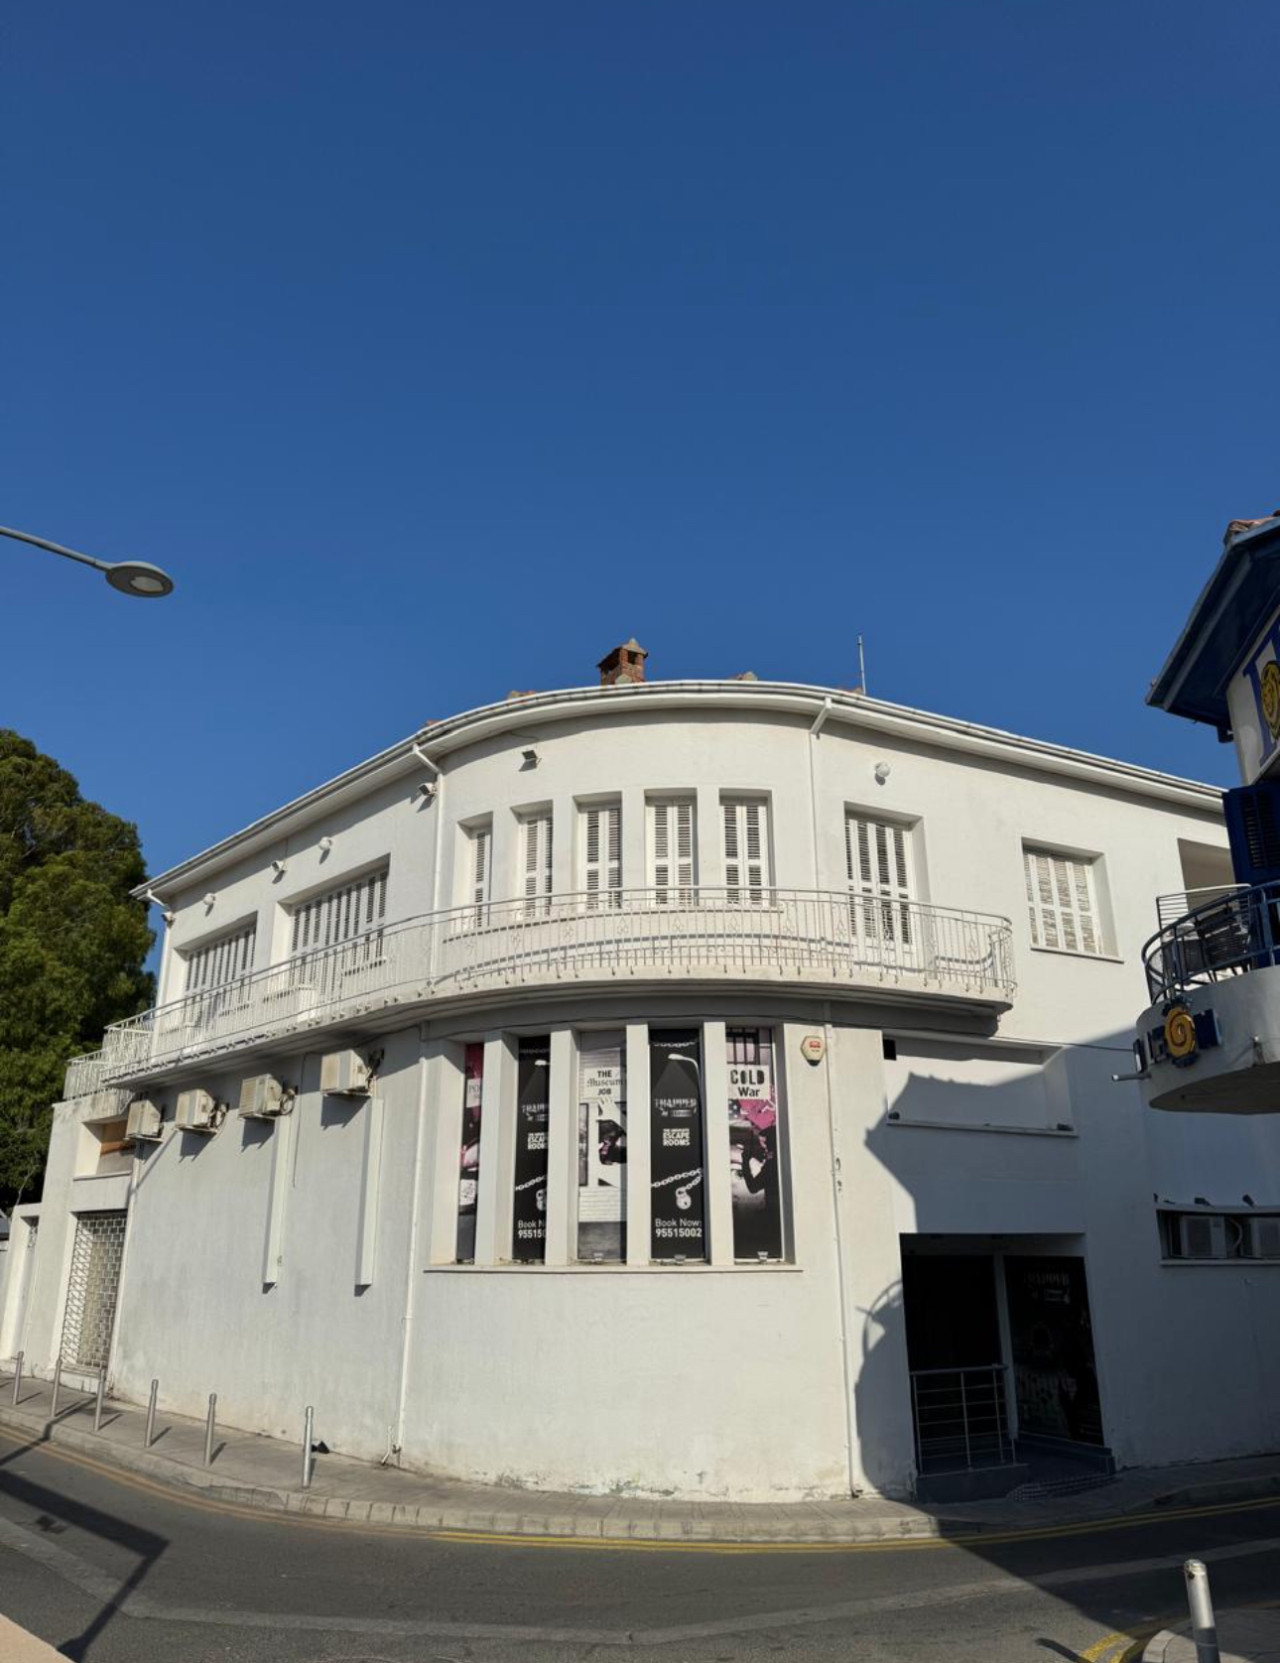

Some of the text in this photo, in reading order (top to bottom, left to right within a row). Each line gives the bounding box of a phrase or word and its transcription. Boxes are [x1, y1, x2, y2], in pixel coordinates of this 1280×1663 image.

[597, 1070, 612, 1078] THE
[730, 1069, 765, 1085] COLD
[738, 1086, 760, 1097] War
[518, 1219, 536, 1228] Book
[655, 1218, 702, 1227] Book Now:
[655, 1228, 702, 1238] 95515002
